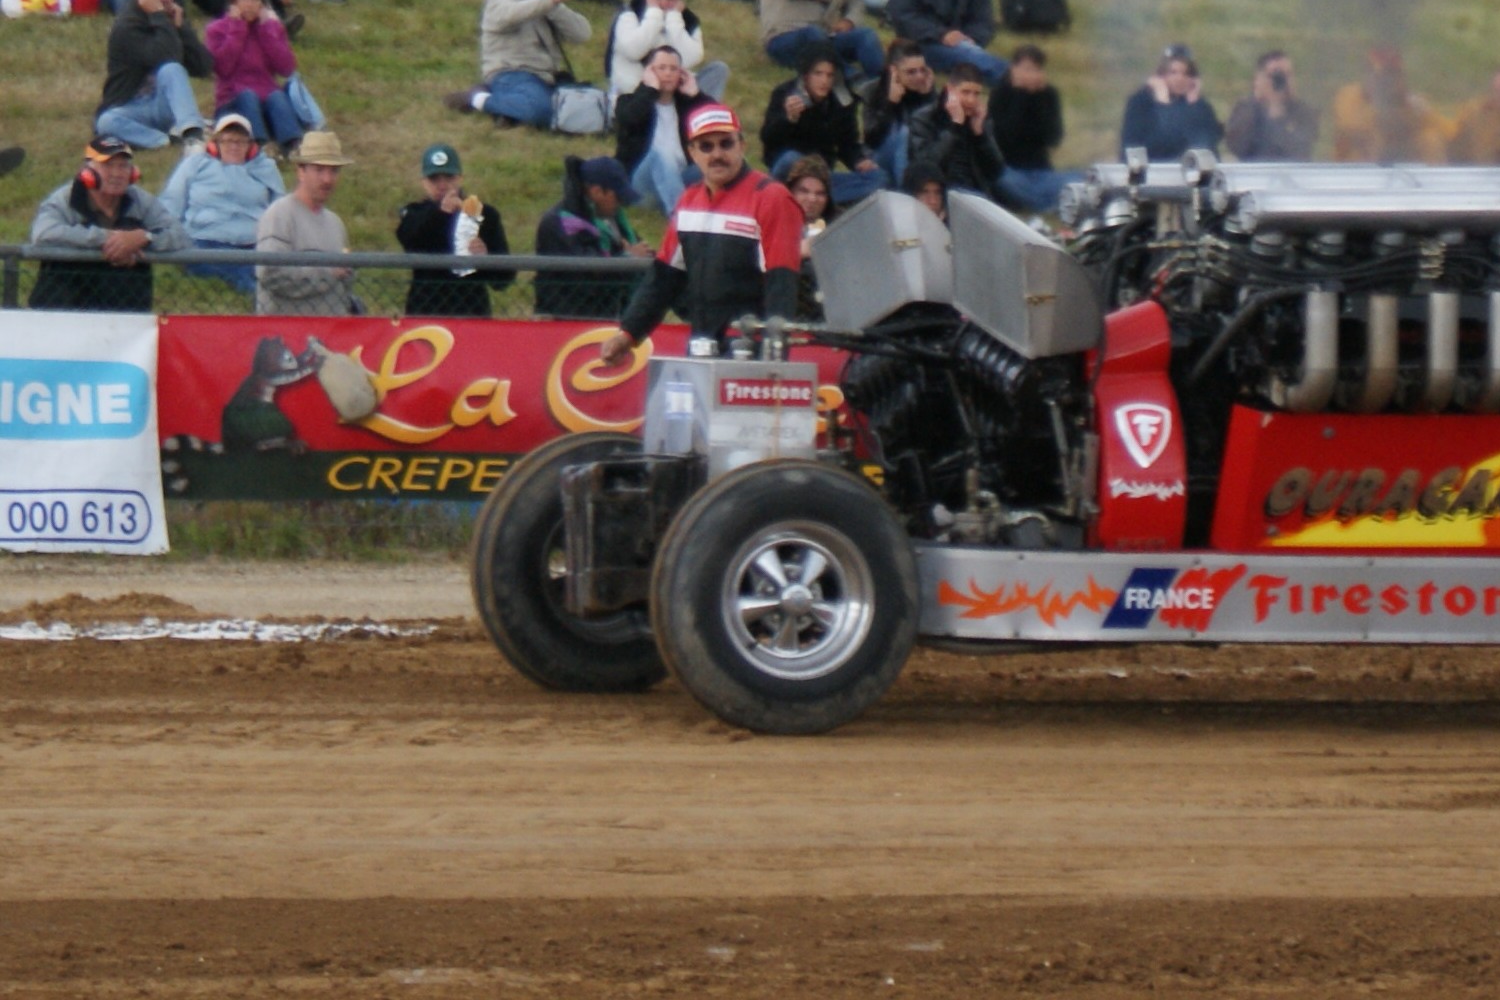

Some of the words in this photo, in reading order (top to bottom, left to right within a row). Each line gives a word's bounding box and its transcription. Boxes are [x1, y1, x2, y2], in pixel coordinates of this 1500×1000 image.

[338, 325, 519, 444] La
[724, 382, 813, 403] Firestone
[8, 501, 69, 533] 000
[81, 501, 138, 535] 613
[1124, 586, 1215, 610] FRANCE
